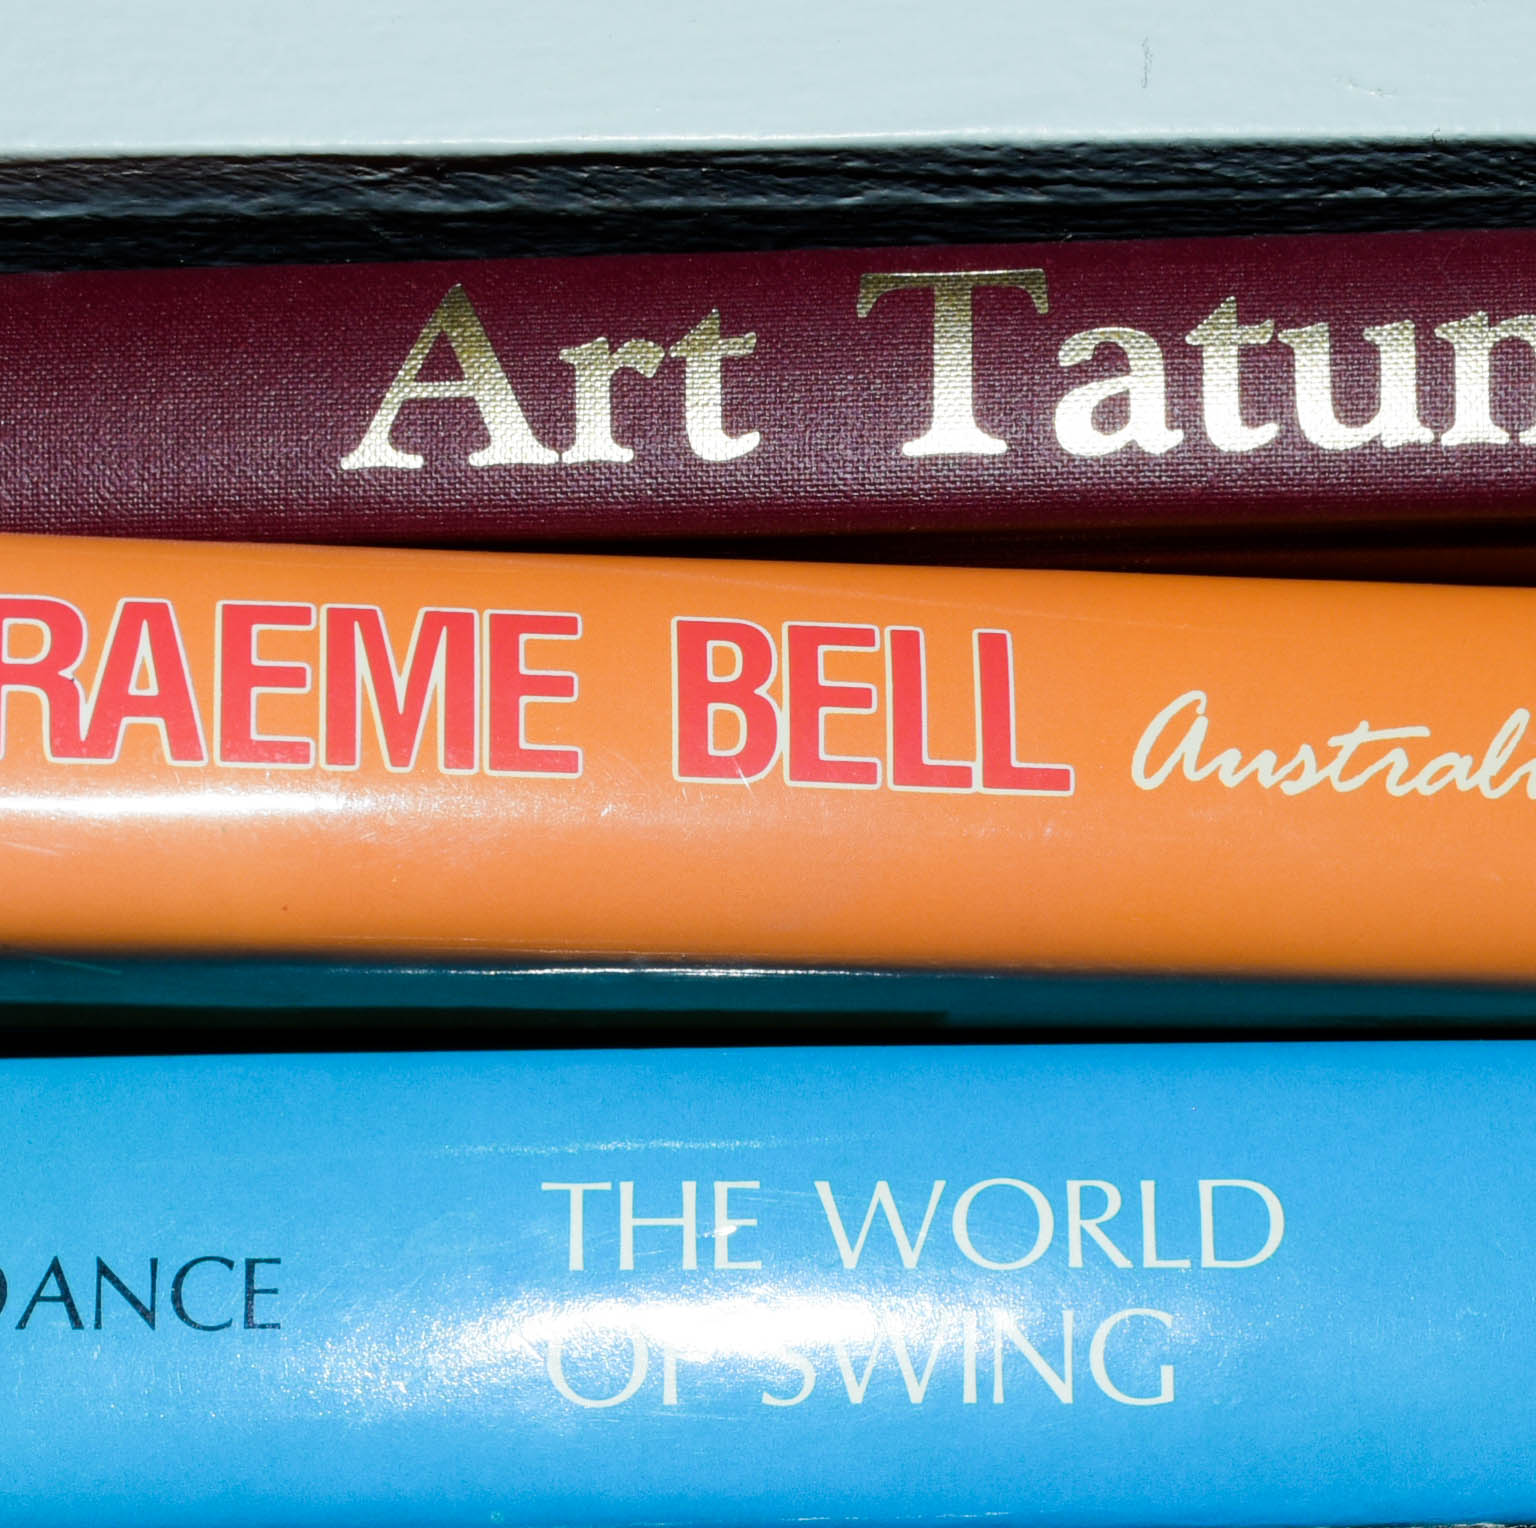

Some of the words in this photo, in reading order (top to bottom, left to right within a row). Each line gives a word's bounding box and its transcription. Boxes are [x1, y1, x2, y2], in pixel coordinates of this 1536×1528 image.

[338, 282, 761, 471] Art
[671, 616, 1075, 797] BELL
[540, 1178, 764, 1273] THE
[813, 1176, 1288, 1272] WORLD
